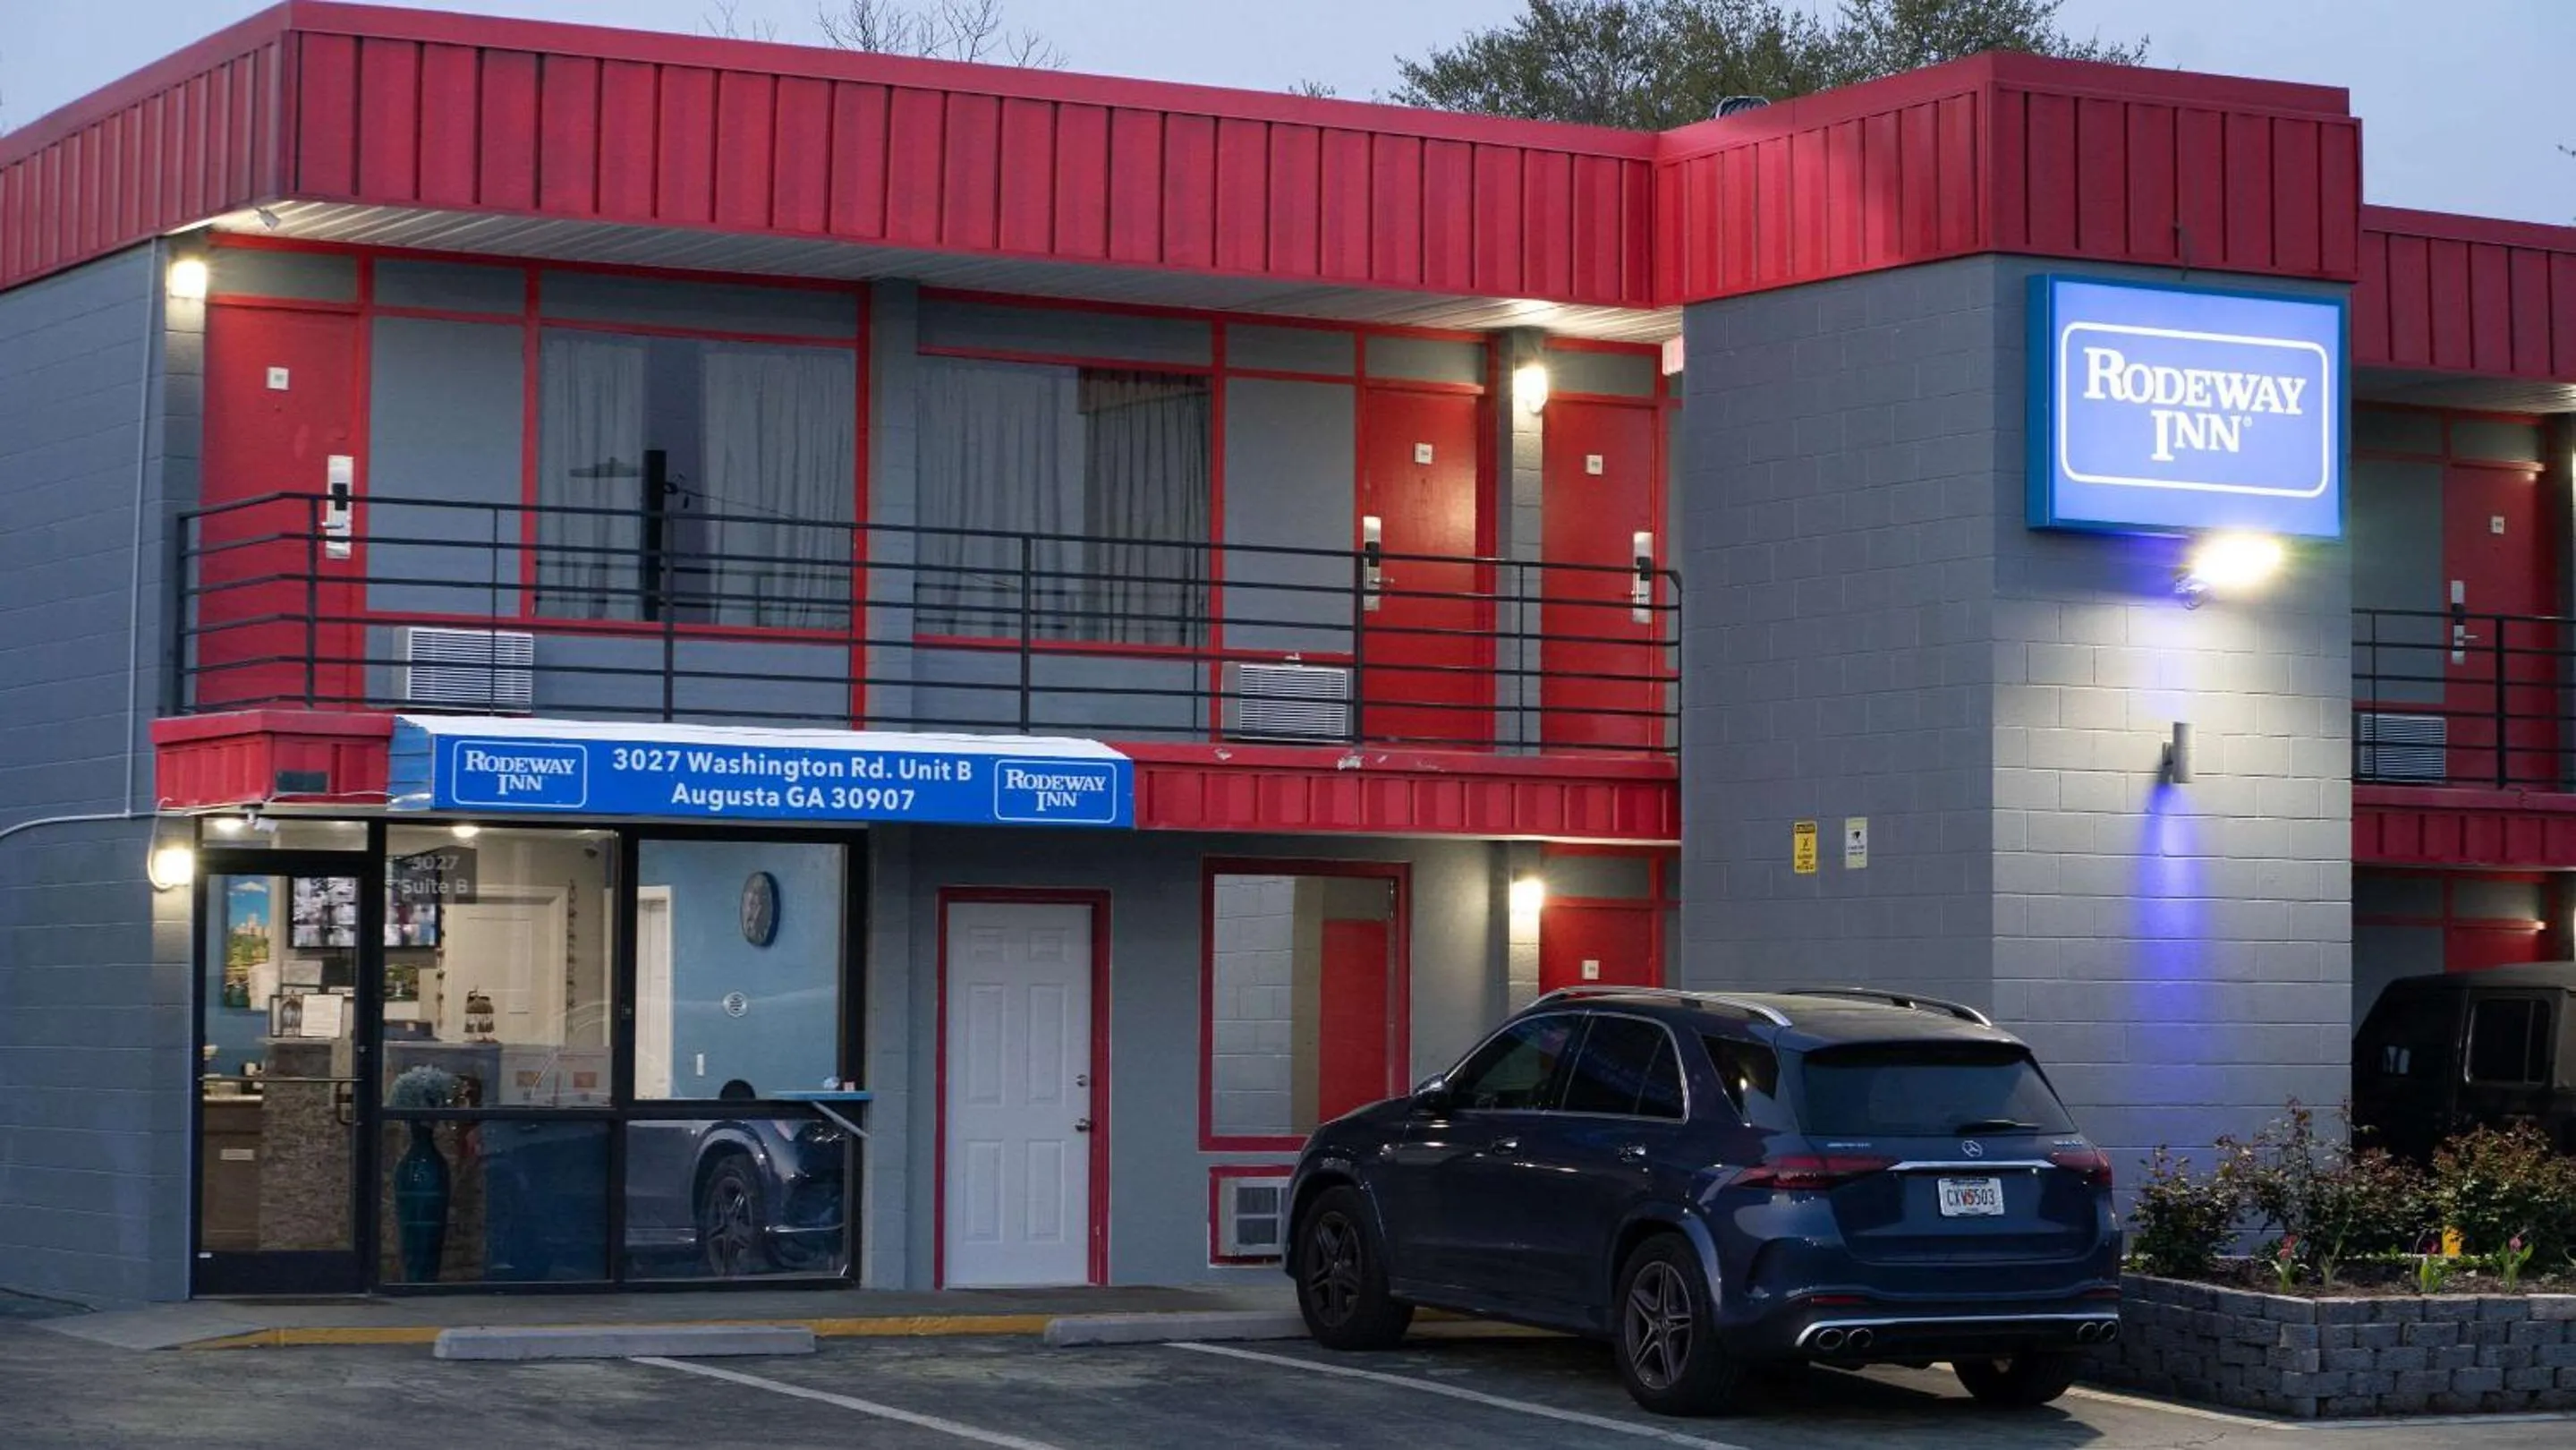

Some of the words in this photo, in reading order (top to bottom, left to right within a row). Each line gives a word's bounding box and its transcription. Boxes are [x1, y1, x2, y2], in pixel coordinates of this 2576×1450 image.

[2082, 346, 2308, 415] RODEWAY
[2150, 409, 2242, 462] INN
[464, 749, 577, 775] RODEWAY
[612, 747, 682, 772] 3027
[686, 750, 845, 783] Washington
[851, 755, 893, 780] Rd.
[898, 758, 952, 781] Unit
[956, 760, 973, 781] B
[497, 773, 544, 796] INN
[1004, 768, 1108, 792] RODEWAY
[671, 781, 780, 812] Augusta
[786, 786, 826, 809] GA
[829, 787, 915, 811] 30907
[1035, 791, 1078, 812] INN
[412, 855, 460, 871] 3027
[400, 878, 450, 894] Suite
[455, 878, 469, 894] B
